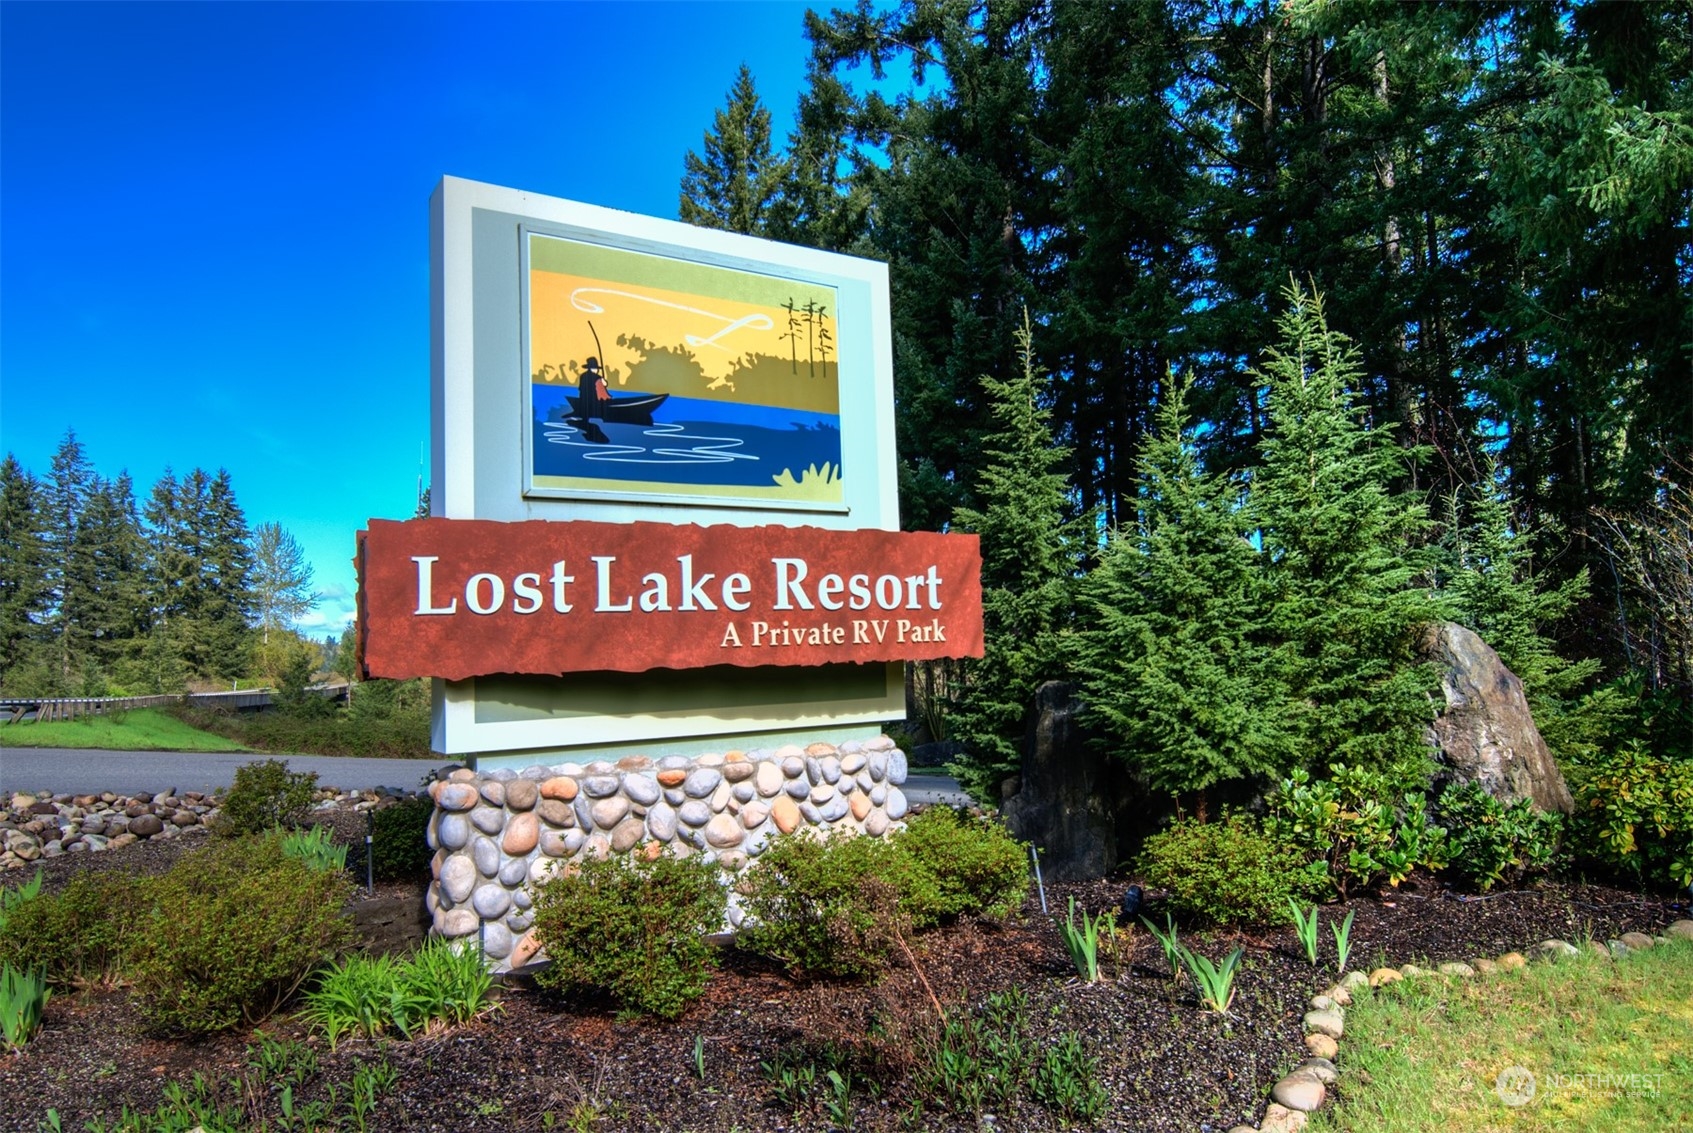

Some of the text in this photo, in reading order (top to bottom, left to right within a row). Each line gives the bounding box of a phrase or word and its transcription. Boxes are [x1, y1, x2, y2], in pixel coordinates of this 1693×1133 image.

[410, 553, 943, 615] Lost Lake Resort
[720, 617, 947, 647] A Private RV Park
